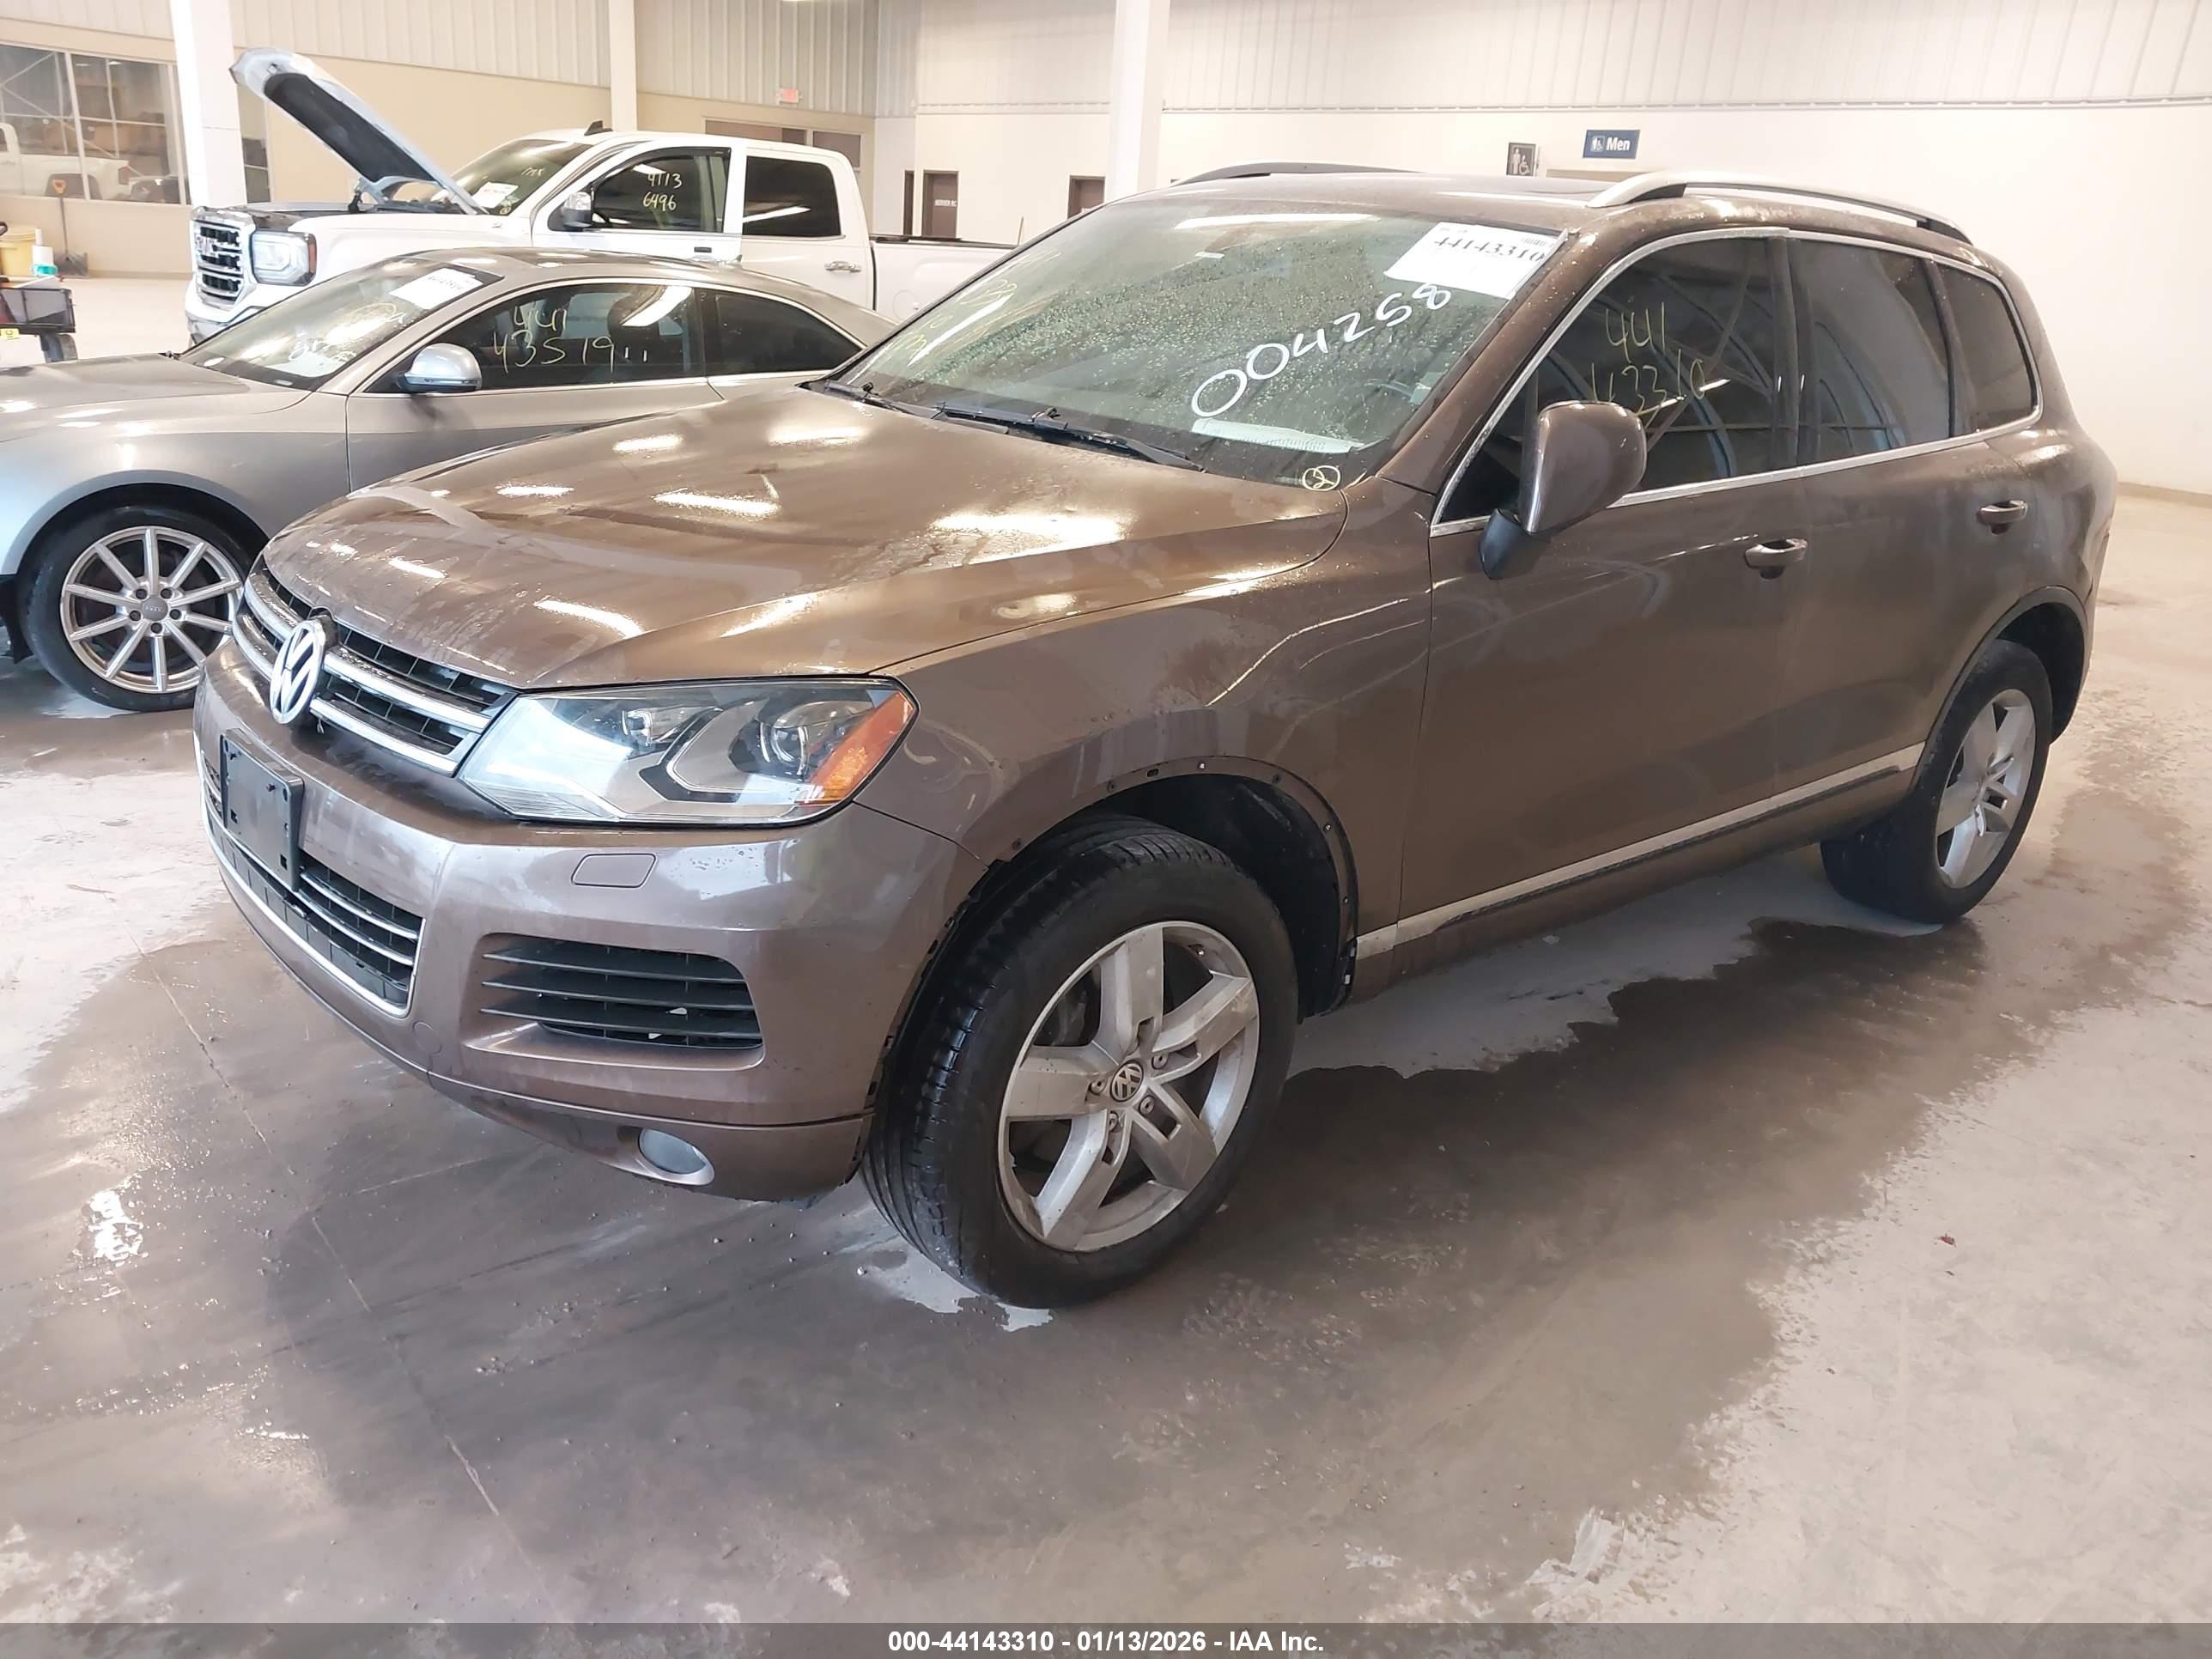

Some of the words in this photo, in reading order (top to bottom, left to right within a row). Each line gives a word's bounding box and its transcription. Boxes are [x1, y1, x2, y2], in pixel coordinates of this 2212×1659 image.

[1606, 137, 1631, 151] Men
[642, 191, 677, 212] 6496
[1433, 236, 1546, 262] 44143310
[514, 305, 568, 337] 441
[1604, 301, 1667, 364] 441
